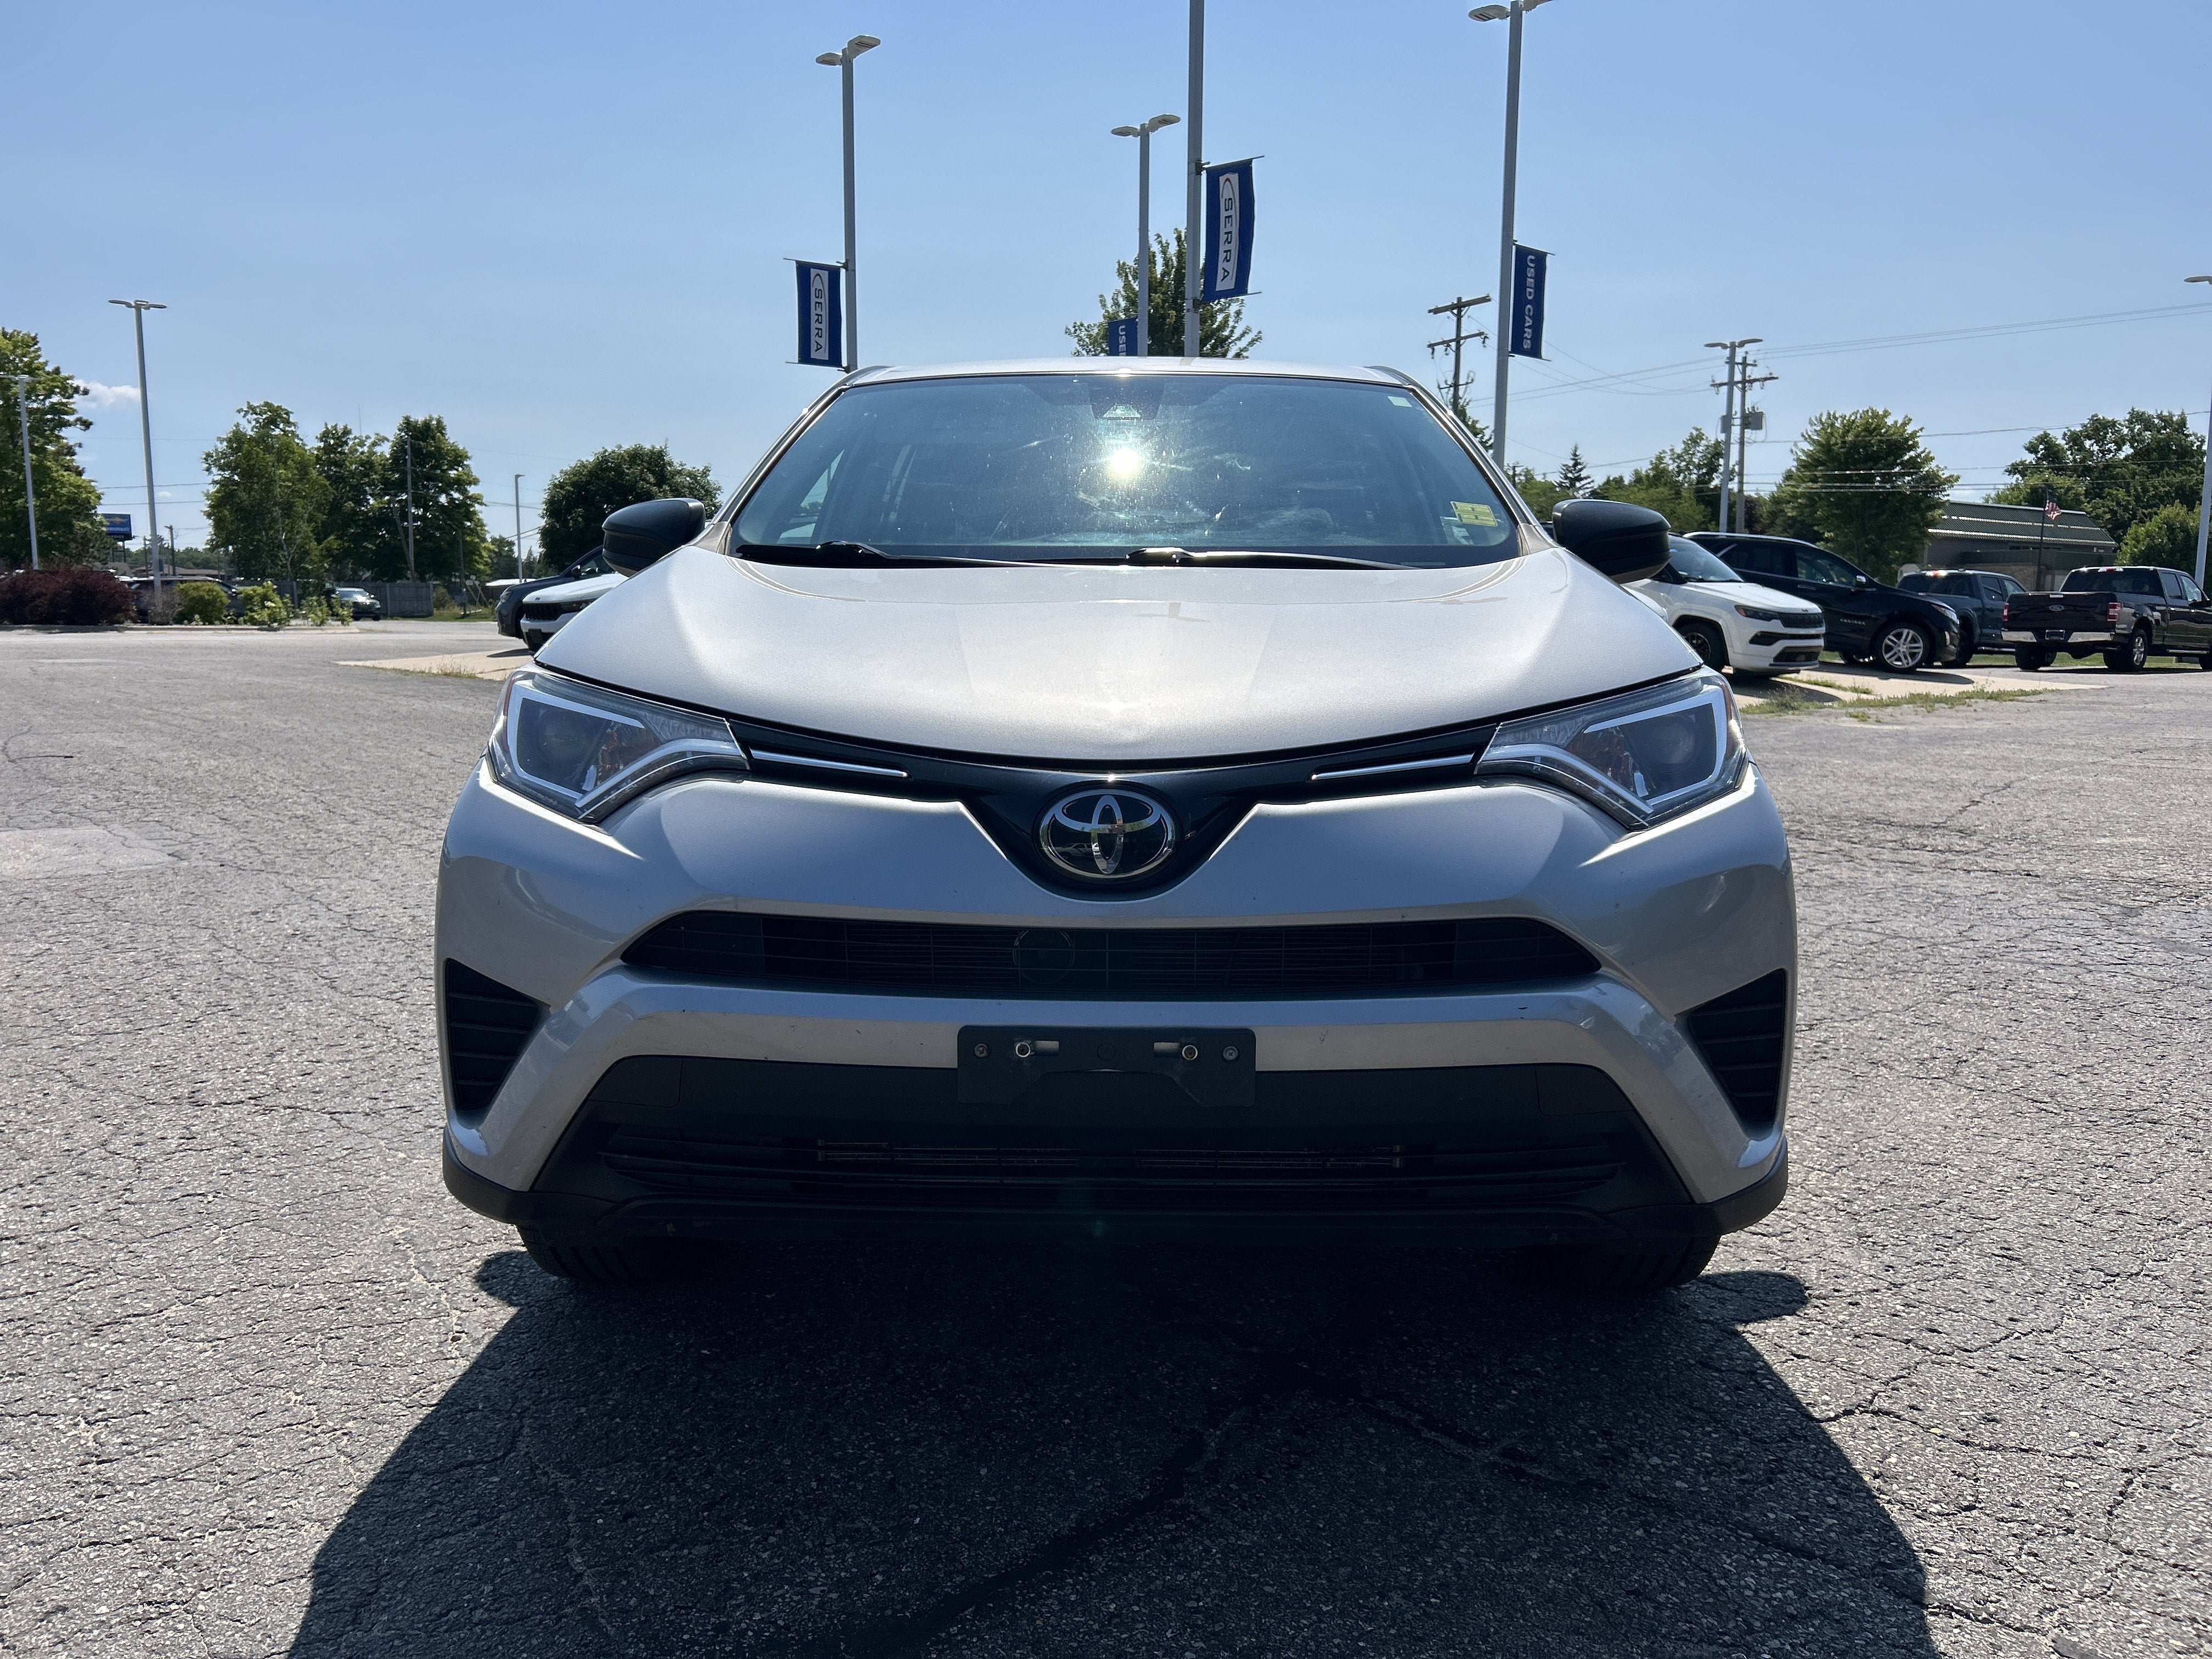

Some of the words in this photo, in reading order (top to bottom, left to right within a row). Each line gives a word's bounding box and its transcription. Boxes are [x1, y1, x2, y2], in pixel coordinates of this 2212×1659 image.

[1221, 198, 1233, 283] SERRA
[1526, 255, 1536, 300] USED
[1522, 304, 1534, 349] CARS
